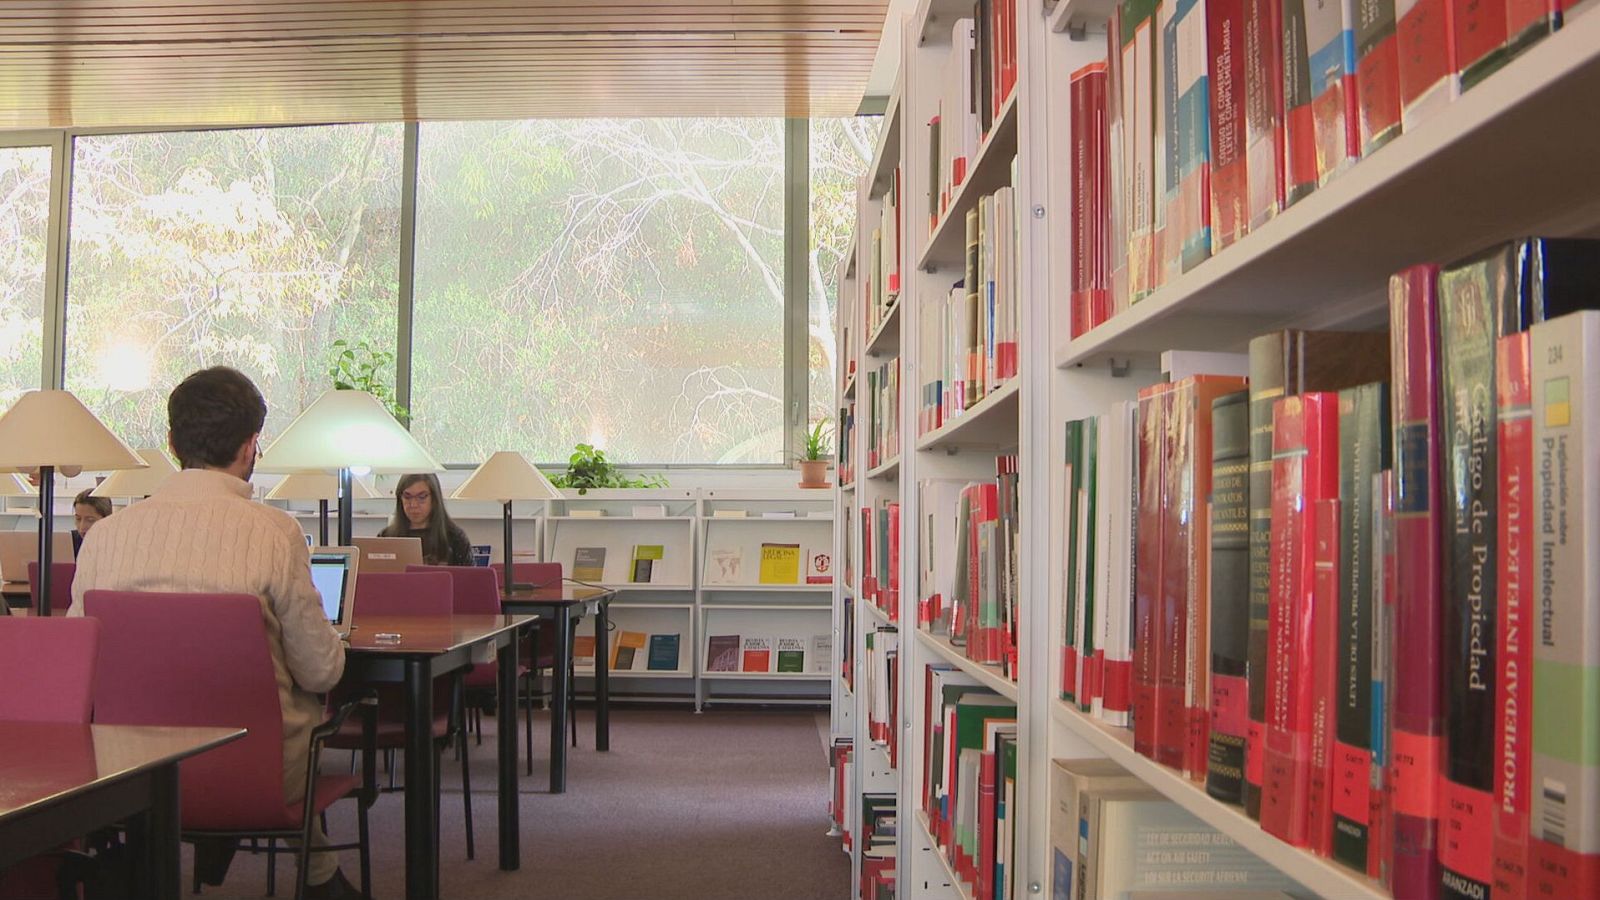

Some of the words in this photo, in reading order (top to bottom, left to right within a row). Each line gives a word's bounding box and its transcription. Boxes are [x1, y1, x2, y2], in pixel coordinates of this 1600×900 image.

[1217, 55, 1226, 109] COMERCIO
[1222, 19, 1233, 120] COMPLEMENTARIAS
[1218, 112, 1225, 124] DE
[1225, 122, 1233, 152] LEYES
[1218, 126, 1226, 166] CÓDIGO
[1226, 155, 1233, 163] Y
[1548, 344, 1562, 364] 234
[1468, 382, 1489, 490] Código
[1352, 441, 1361, 529] INDUSTRIAL
[1540, 437, 1556, 534] Propiedad
[1557, 434, 1569, 507] Legislación
[1472, 499, 1488, 534] de
[1557, 510, 1568, 546] sobre
[1350, 533, 1360, 617] PROPIEDAD
[1505, 466, 1521, 654] INTELECTUAL
[1277, 604, 1284, 623] DE
[1541, 541, 1556, 647] Intelectual
[1350, 620, 1358, 639] LA
[1467, 545, 1489, 691] Propiedad
[1284, 640, 1290, 650] Y
[1350, 643, 1358, 662] DE
[1274, 626, 1283, 731] LEGISLACIÓN
[1280, 654, 1289, 733] PATENTES
[1349, 665, 1357, 708] LEYES
[1502, 661, 1518, 814] PROPIEDAD
[1146, 852, 1160, 864] ACT
[1161, 852, 1172, 864] ON
[1187, 852, 1210, 865] SAFETY
[1442, 870, 1486, 900] ARANZADI
